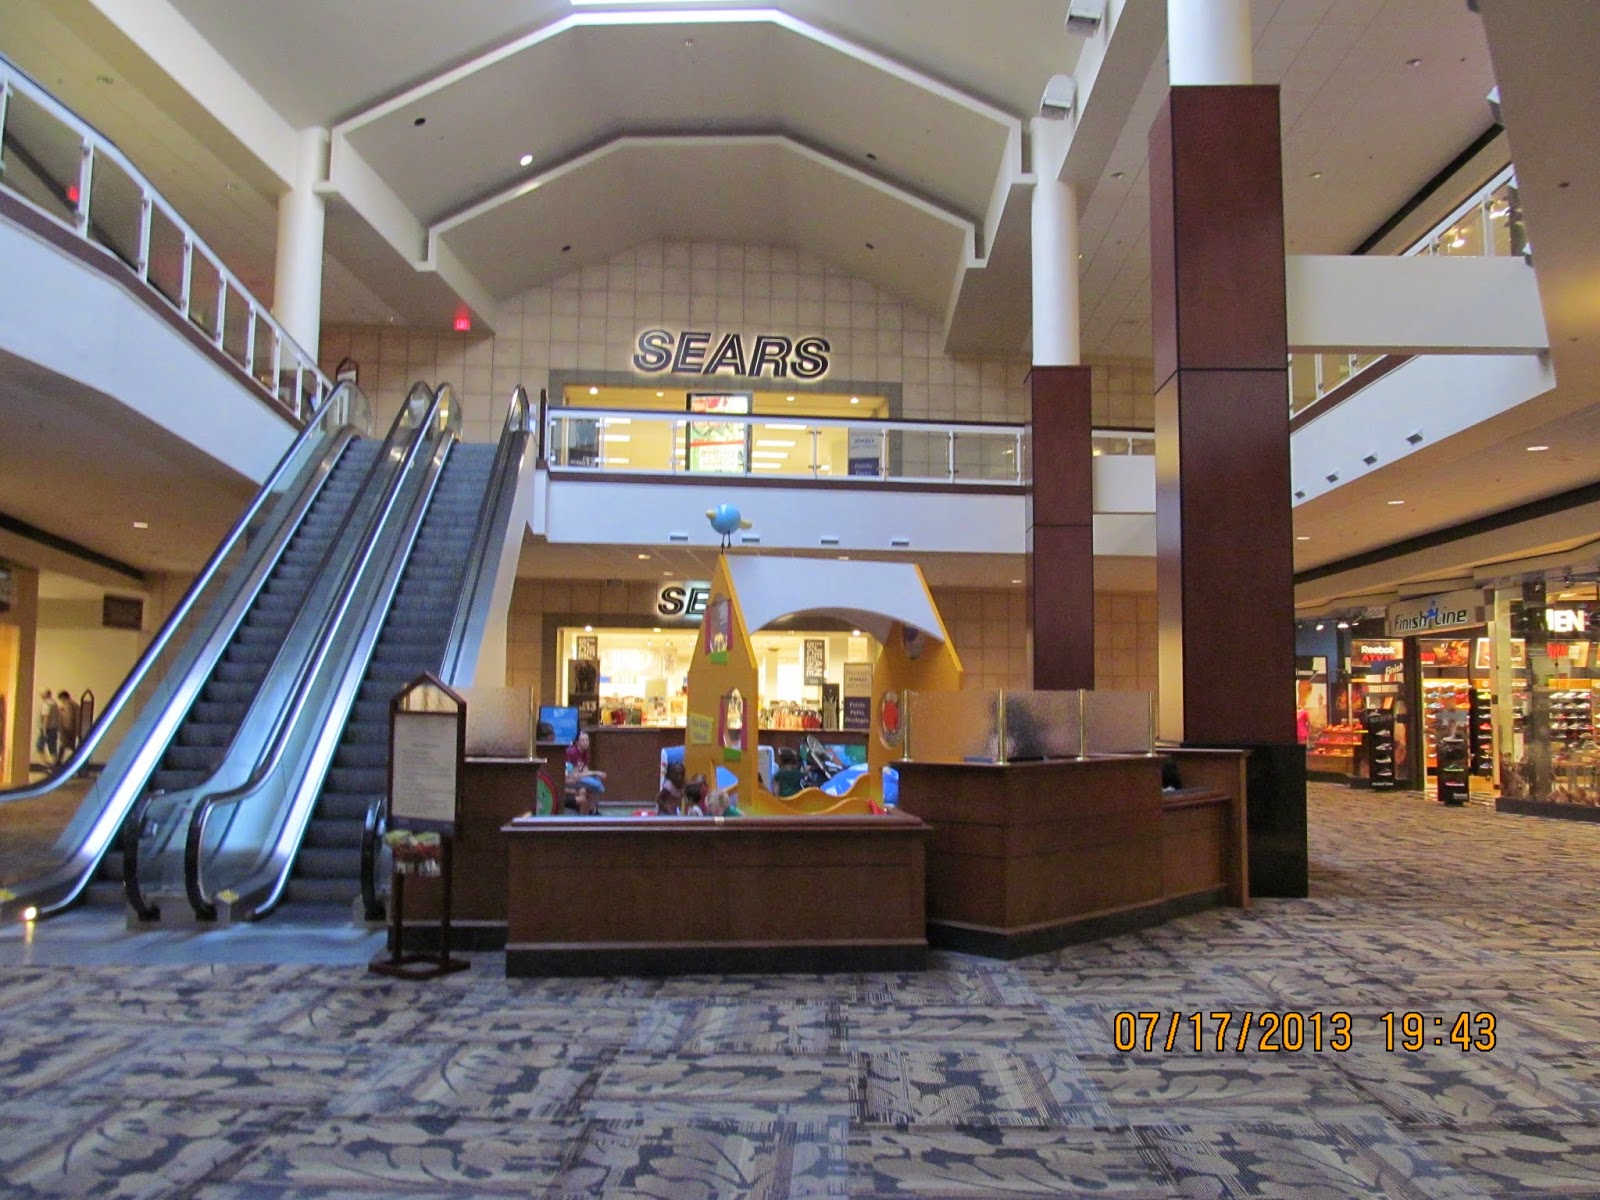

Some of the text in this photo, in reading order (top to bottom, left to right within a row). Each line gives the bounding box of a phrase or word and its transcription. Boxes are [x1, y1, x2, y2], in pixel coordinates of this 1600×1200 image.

[633, 329, 831, 379] SEARS
[658, 586, 711, 615] SE
[1394, 607, 1467, 631] Finish Line
[806, 641, 814, 677] SCENE
[814, 646, 823, 677] JEAN
[1361, 645, 1395, 654] Reebok
